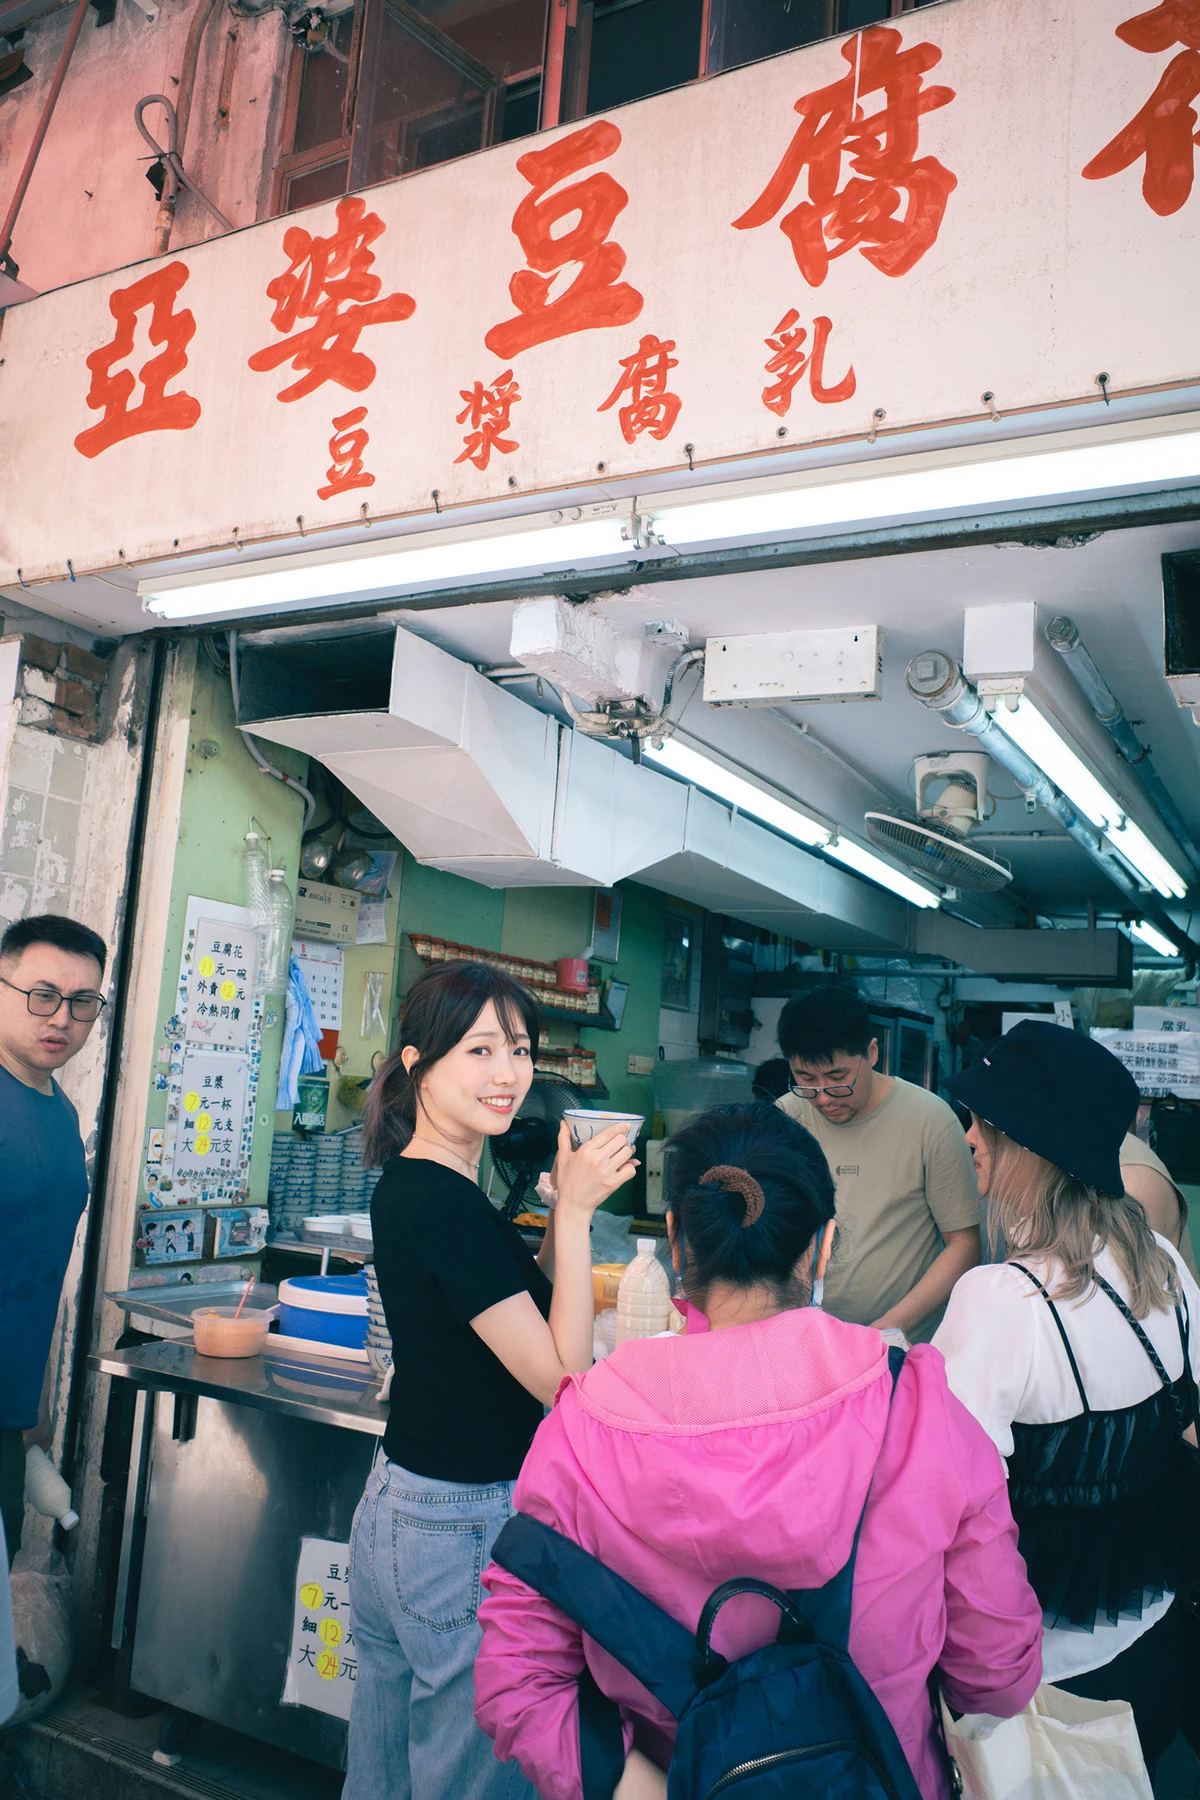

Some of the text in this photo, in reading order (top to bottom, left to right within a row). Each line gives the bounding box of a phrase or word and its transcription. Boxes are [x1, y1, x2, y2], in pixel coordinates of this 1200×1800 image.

[211, 941, 243, 959] 豆腐花
[201, 961, 247, 980] 11元一碗
[197, 1002, 241, 1021] 冷熱同價
[202, 1075, 224, 1089] 豆漿
[189, 1094, 232, 1111] 7元一杯
[184, 1116, 234, 1132] 細12元支
[181, 1138, 233, 1153] 大24元支
[298, 1644, 358, 1681] 大24元
